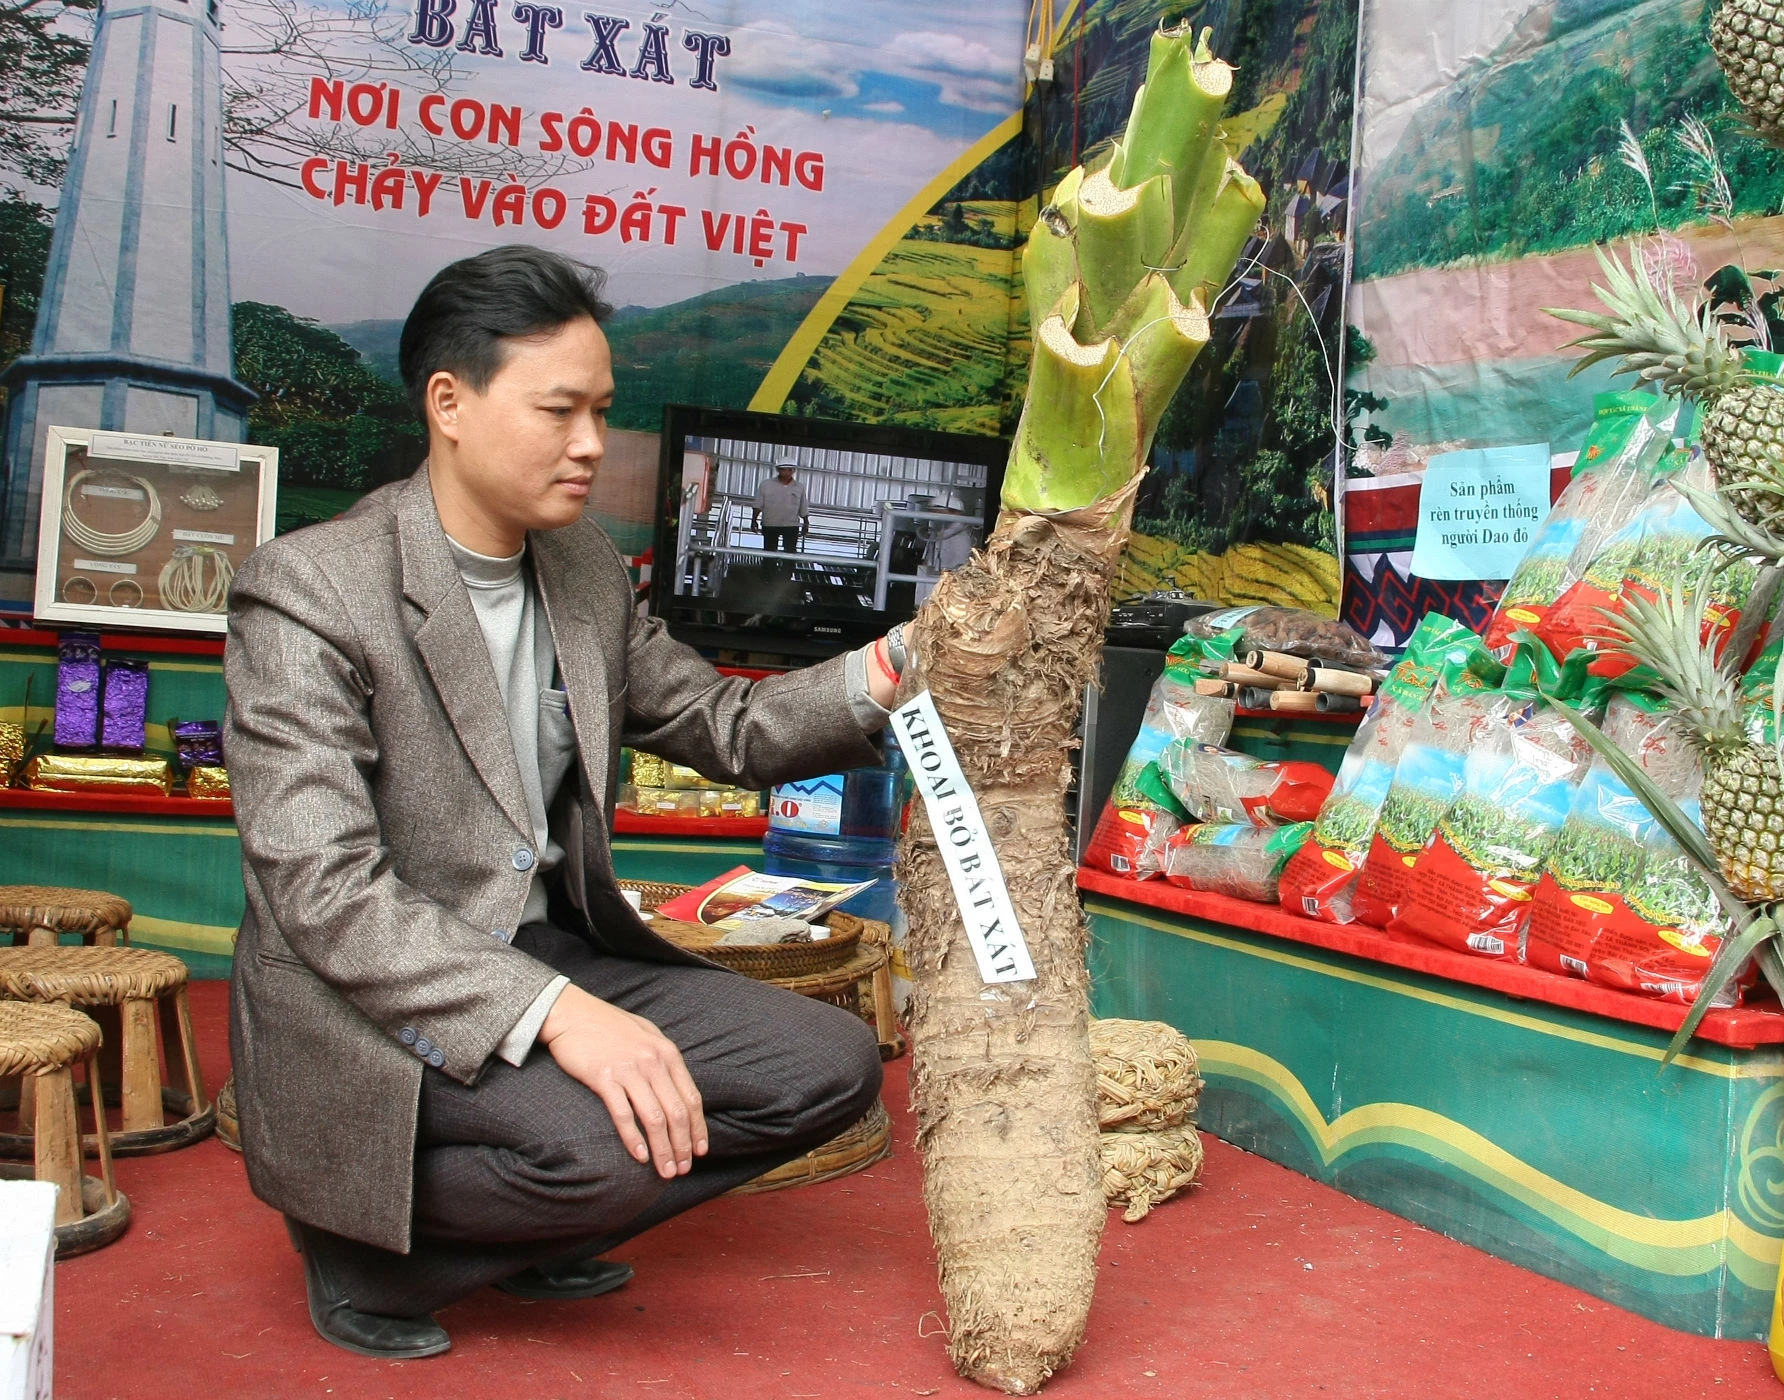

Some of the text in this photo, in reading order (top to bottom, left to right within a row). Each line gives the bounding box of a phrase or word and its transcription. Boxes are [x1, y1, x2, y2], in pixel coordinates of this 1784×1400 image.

[580, 12, 731, 91] XÁT
[308, 77, 824, 192] NƠI CON SÔNG HỒNG
[301, 151, 808, 267] CHẢY VÀO ĐẤT VIỆT
[1430, 498, 1539, 524] rèn truyền thống
[1450, 475, 1515, 500] Sản phẩm
[1441, 527, 1529, 548] người Dao đỏ
[901, 706, 1019, 976] KHOAI BỞ BÁT XÁT
